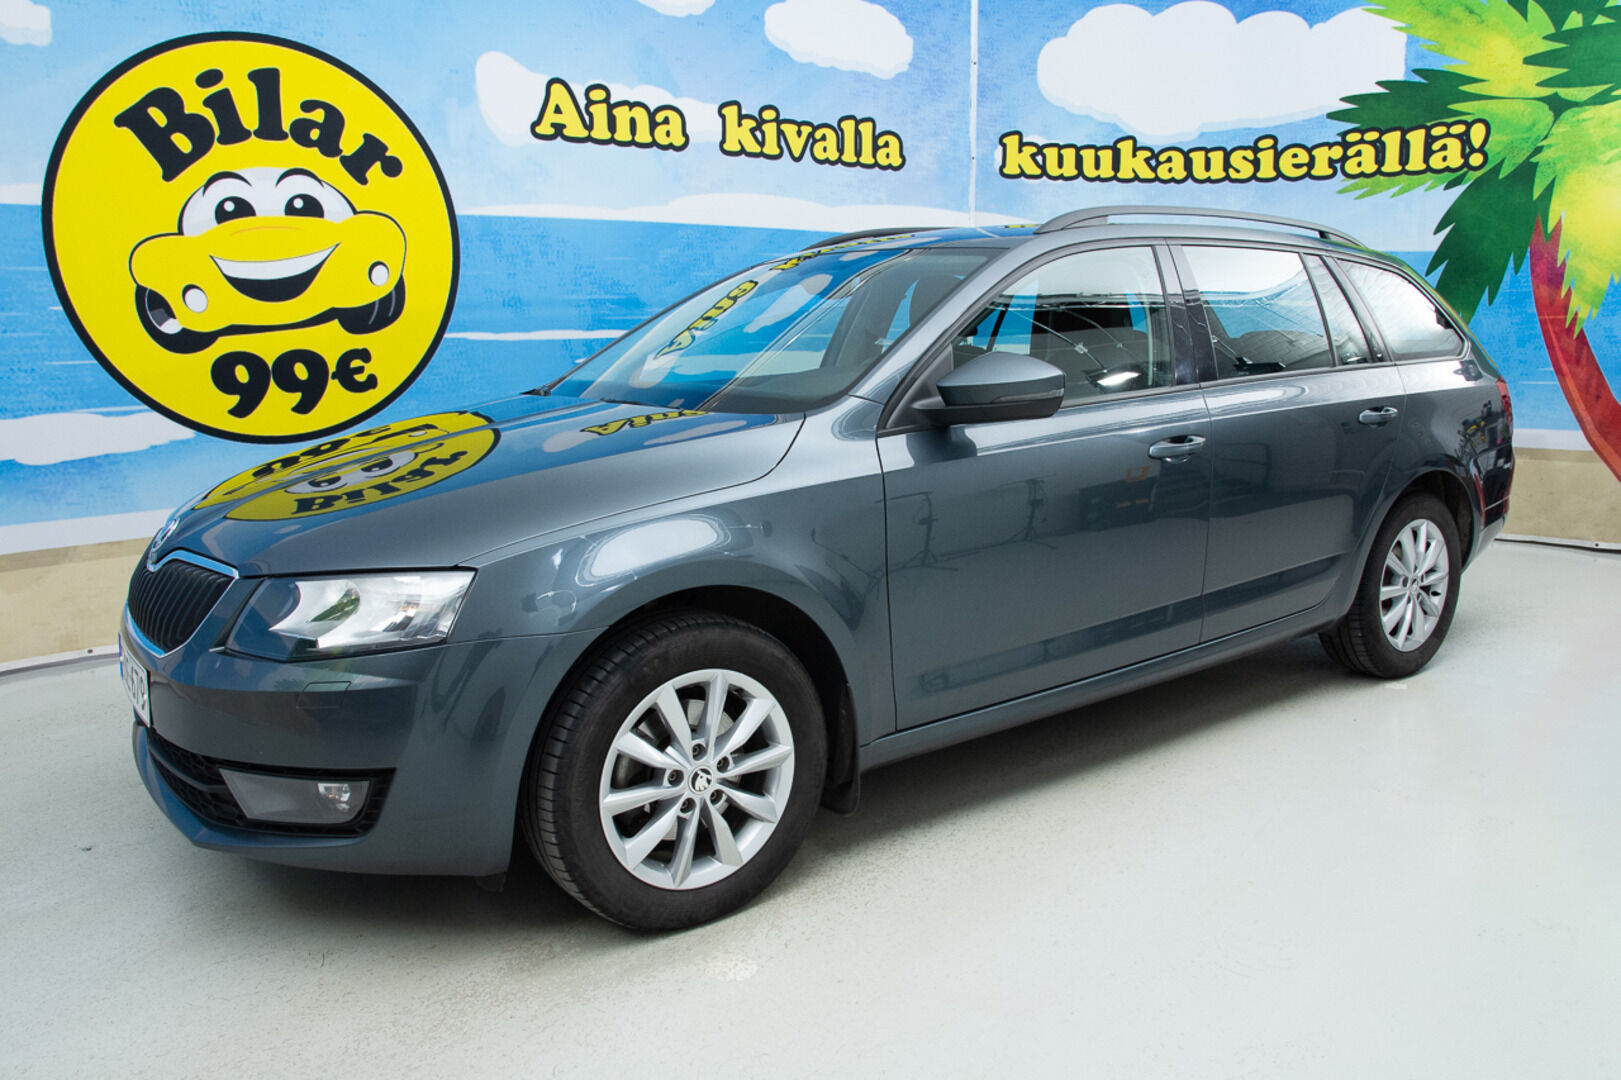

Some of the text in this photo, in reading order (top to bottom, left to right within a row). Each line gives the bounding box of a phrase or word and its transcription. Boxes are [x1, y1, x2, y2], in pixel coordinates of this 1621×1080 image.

[114, 68, 403, 185] Bilar
[531, 78, 1490, 183] Aina kivalla kuukausierällä!
[211, 348, 378, 418] 99€
